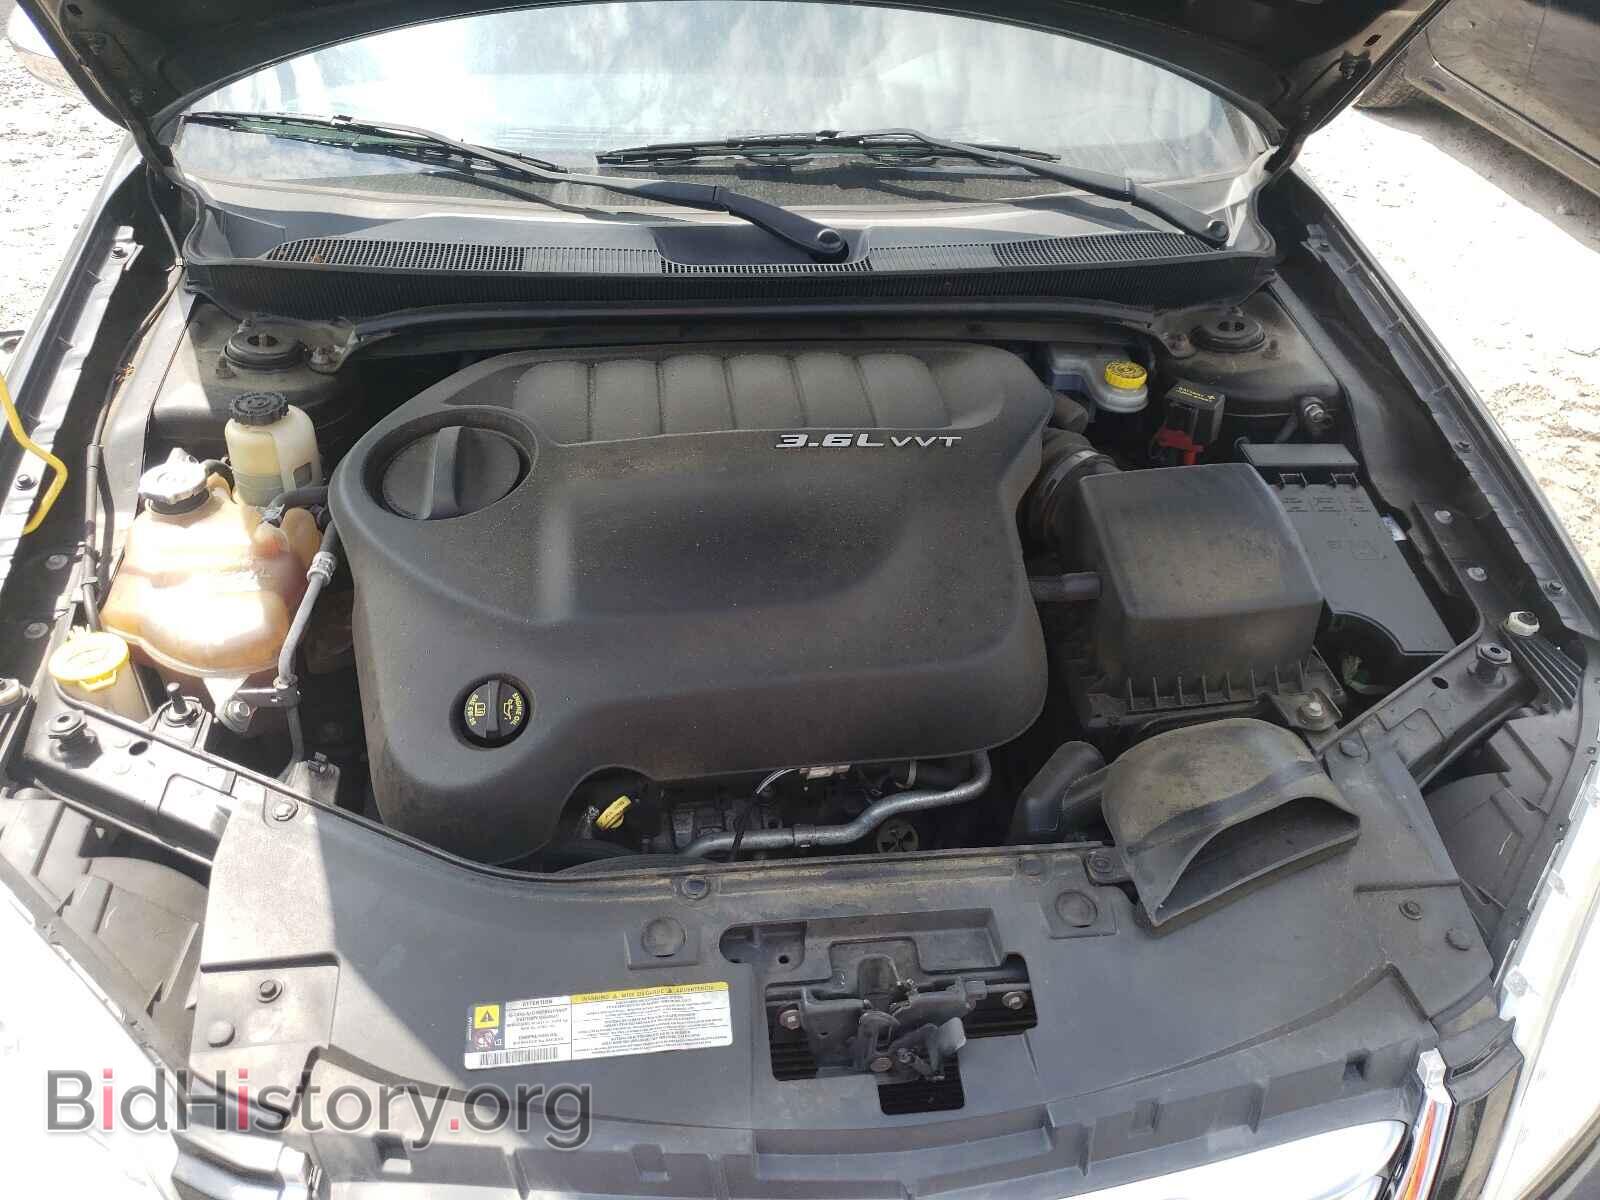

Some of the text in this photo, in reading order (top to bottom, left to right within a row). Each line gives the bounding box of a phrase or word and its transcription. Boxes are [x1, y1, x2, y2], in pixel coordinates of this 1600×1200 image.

[775, 433, 962, 448] 3.6L VVT
[510, 693, 522, 726] ENGINE OIL
